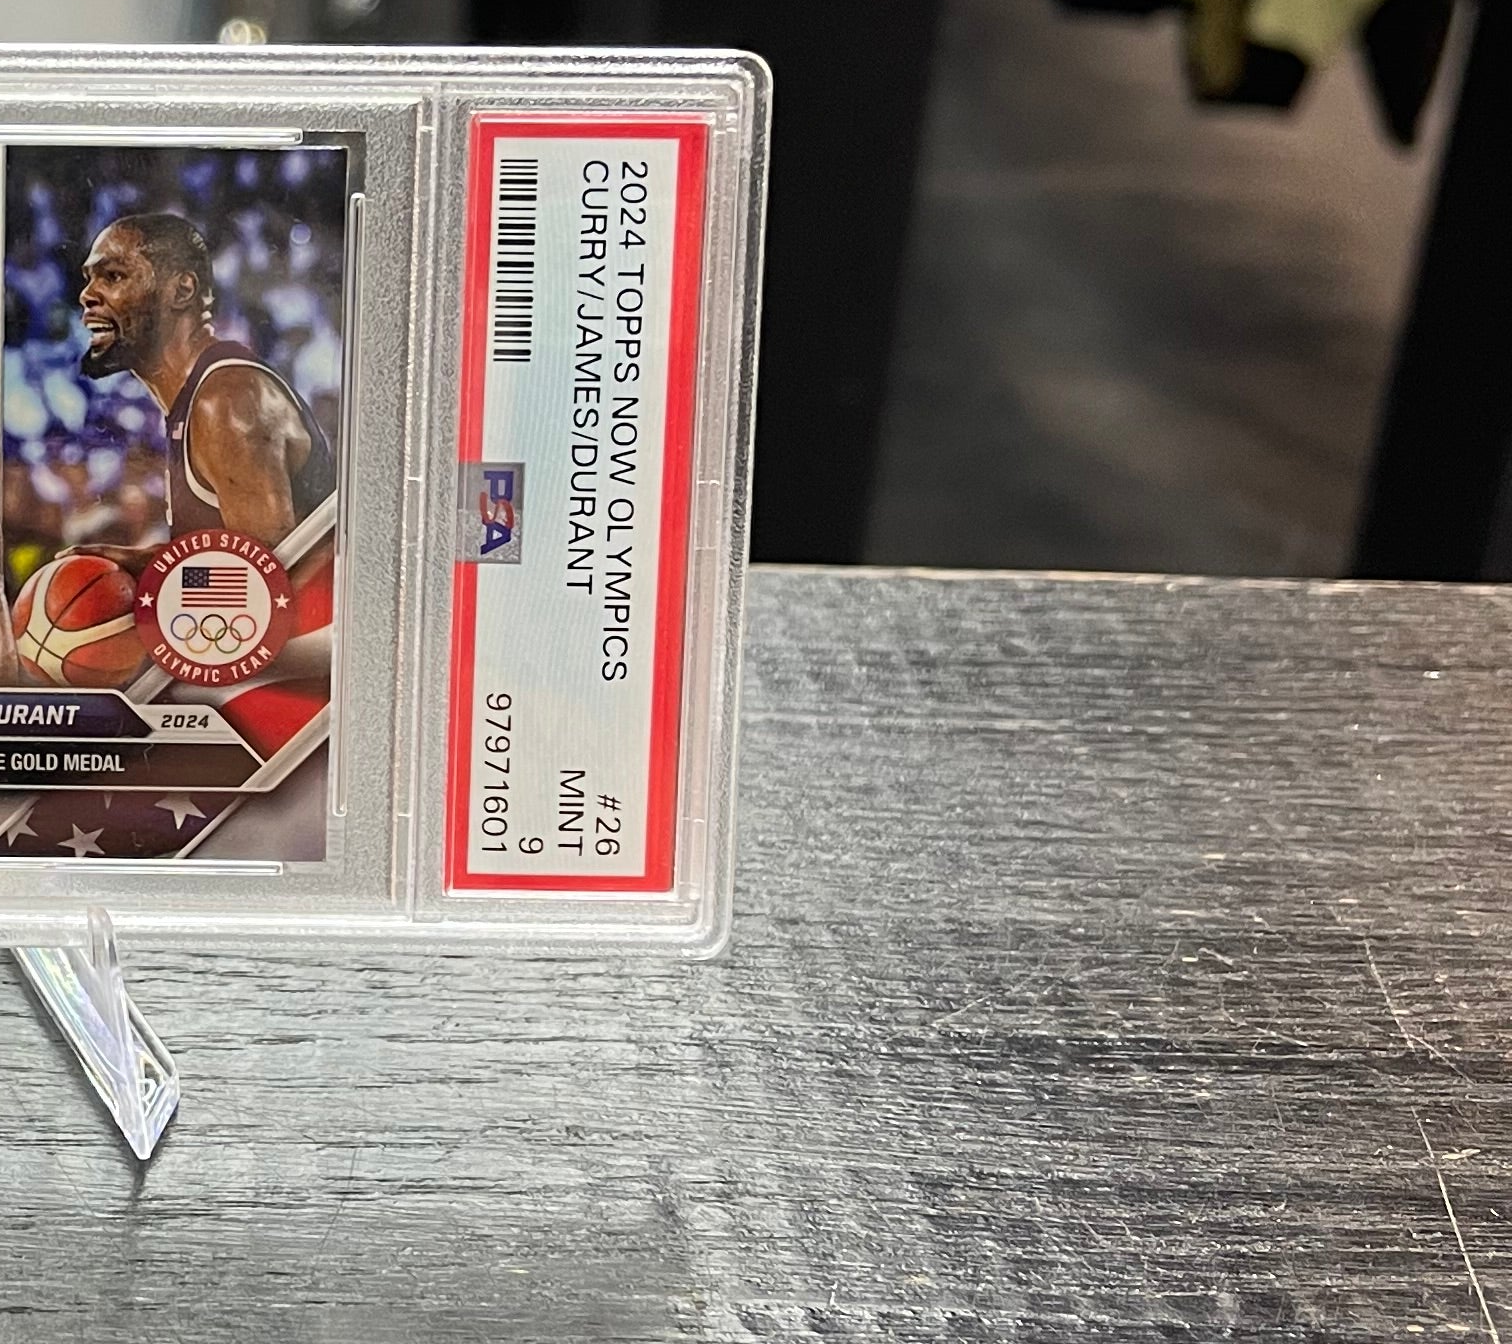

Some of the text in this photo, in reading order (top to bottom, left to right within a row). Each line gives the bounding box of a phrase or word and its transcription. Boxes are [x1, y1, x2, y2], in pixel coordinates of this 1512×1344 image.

[480, 470, 515, 555] PSA
[558, 160, 609, 856] CURRY/JAMES/DURANT MINT
[595, 160, 648, 856] 2024 TOPPS NOW OLYMPICS #26
[153, 533, 277, 575] UNITED STATES
[153, 643, 273, 683] OLYMPIC TEAM
[160, 714, 210, 729] 2024
[11, 752, 58, 772] GOLD
[63, 753, 125, 772] MEDAL
[481, 693, 512, 853] 97971601
[519, 836, 544, 855] 9
